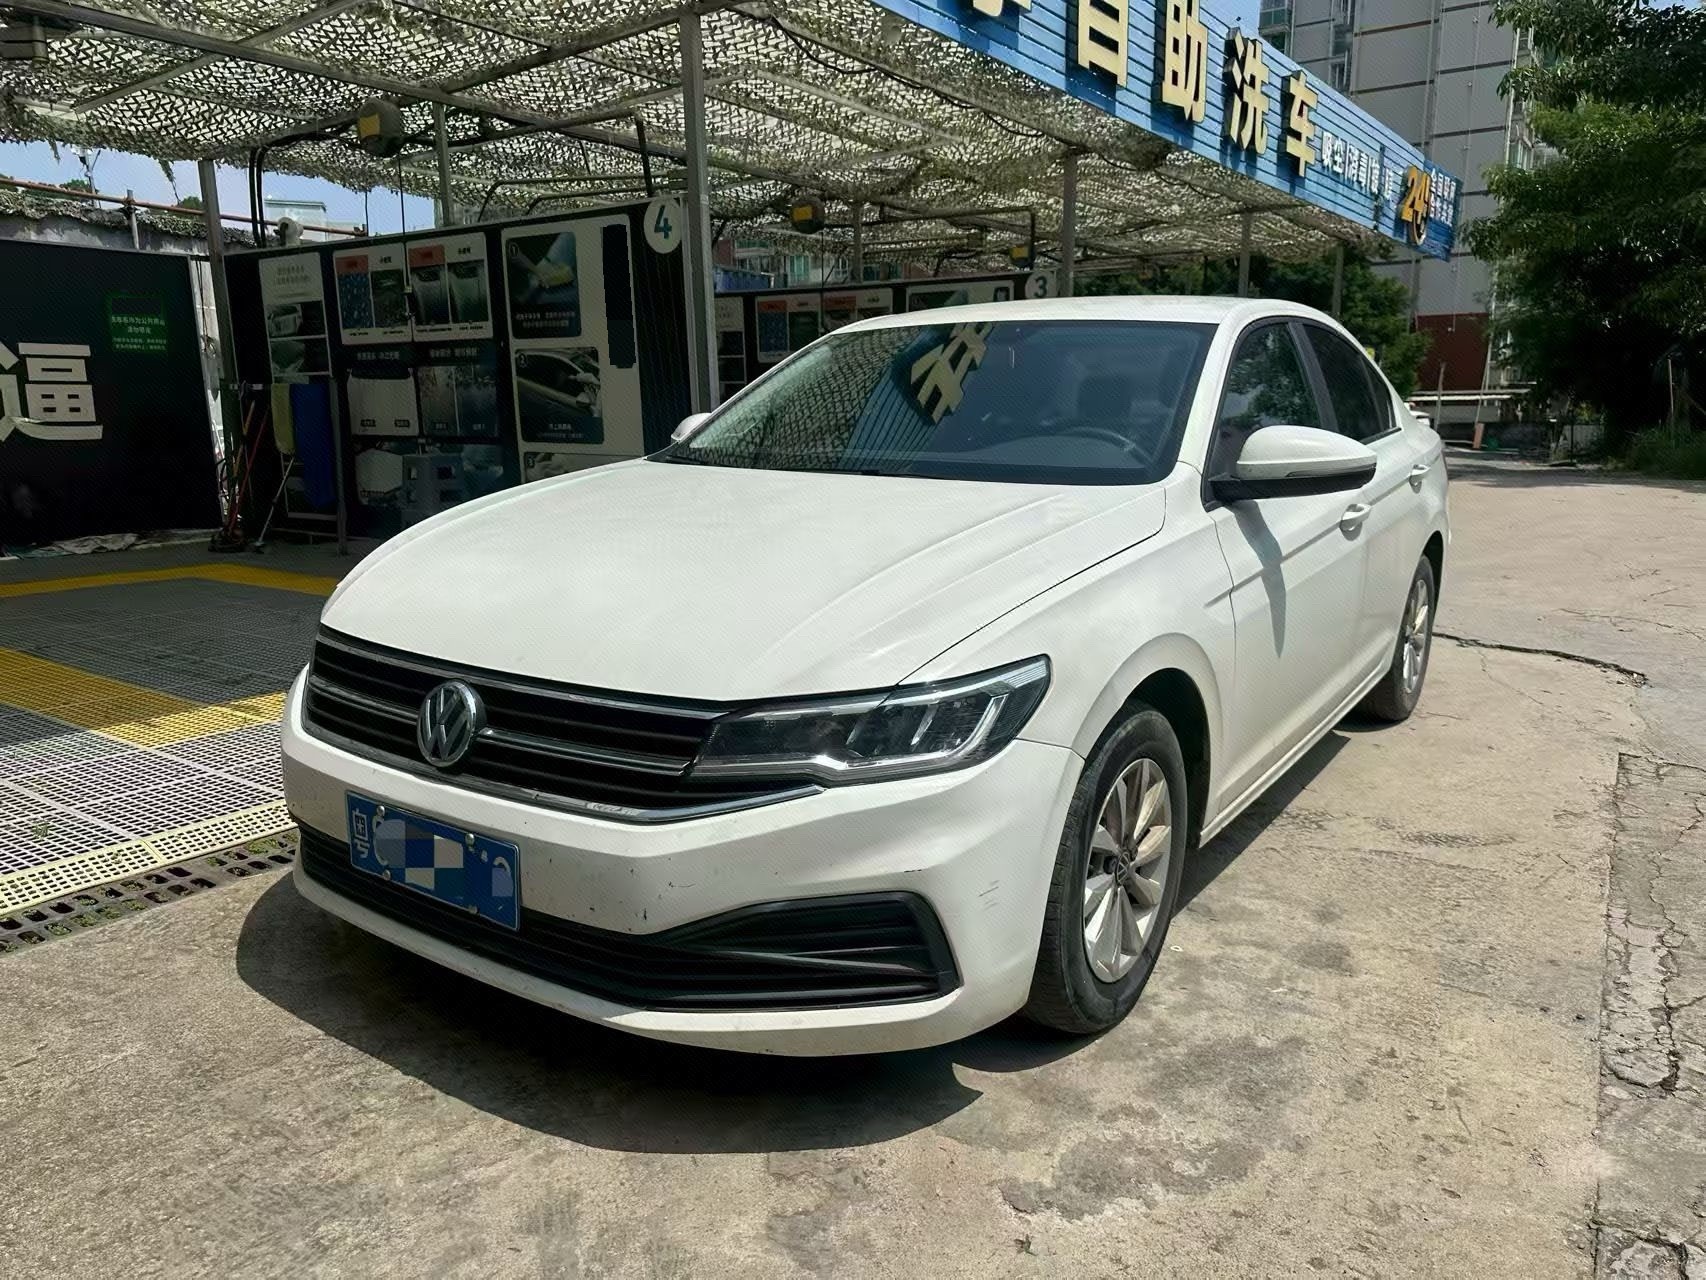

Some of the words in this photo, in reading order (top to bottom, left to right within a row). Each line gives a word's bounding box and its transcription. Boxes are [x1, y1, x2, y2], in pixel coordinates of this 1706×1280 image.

[973, 0, 1318, 177] 自助洗车
[654, 205, 672, 239] 4
[1034, 276, 1047, 297] 3
[352, 808, 370, 858] 粤
